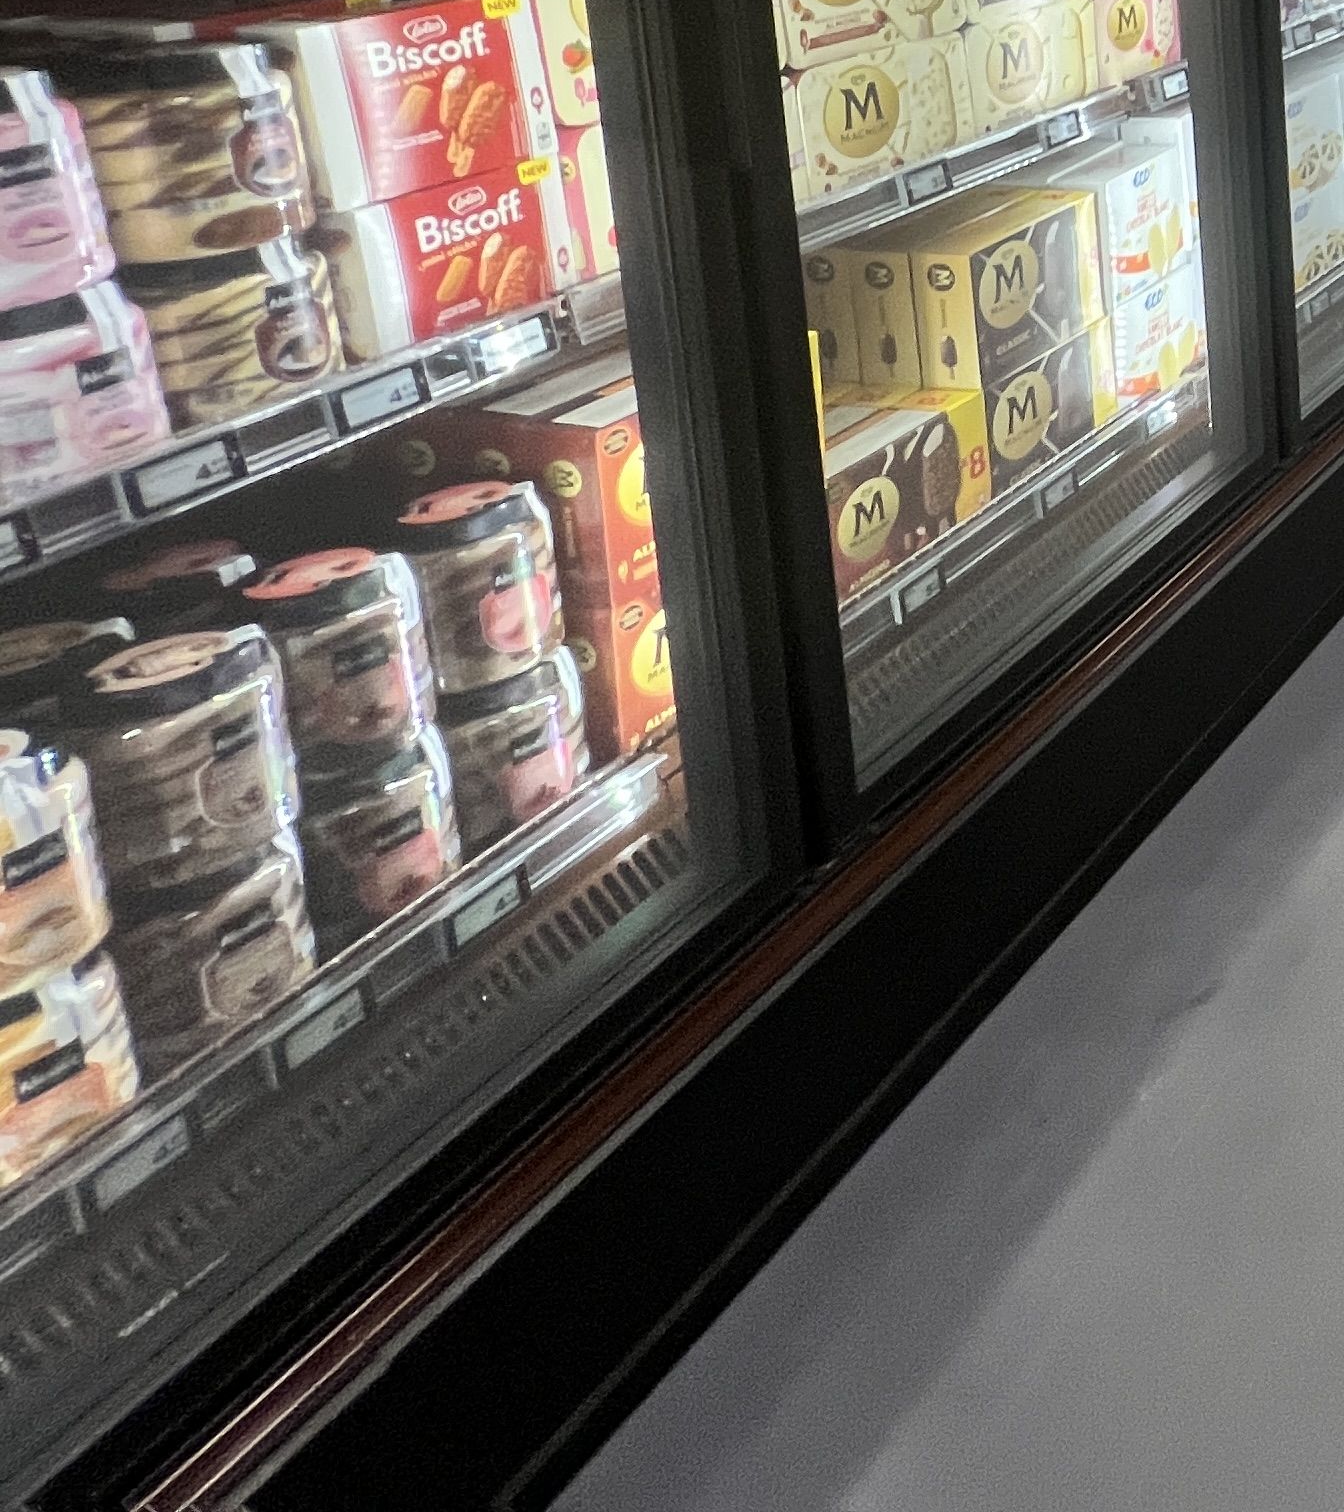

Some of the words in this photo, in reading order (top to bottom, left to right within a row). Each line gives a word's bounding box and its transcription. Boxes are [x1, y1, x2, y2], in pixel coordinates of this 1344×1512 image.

[1117, 5, 1138, 34] M
[366, 21, 488, 78] Biscoff
[1000, 37, 1031, 80] M
[840, 81, 885, 131] M
[522, 163, 548, 178] NEW
[414, 188, 522, 254] Biscoff
[993, 254, 1027, 305] M
[1007, 386, 1038, 436] M
[852, 490, 886, 538] M
